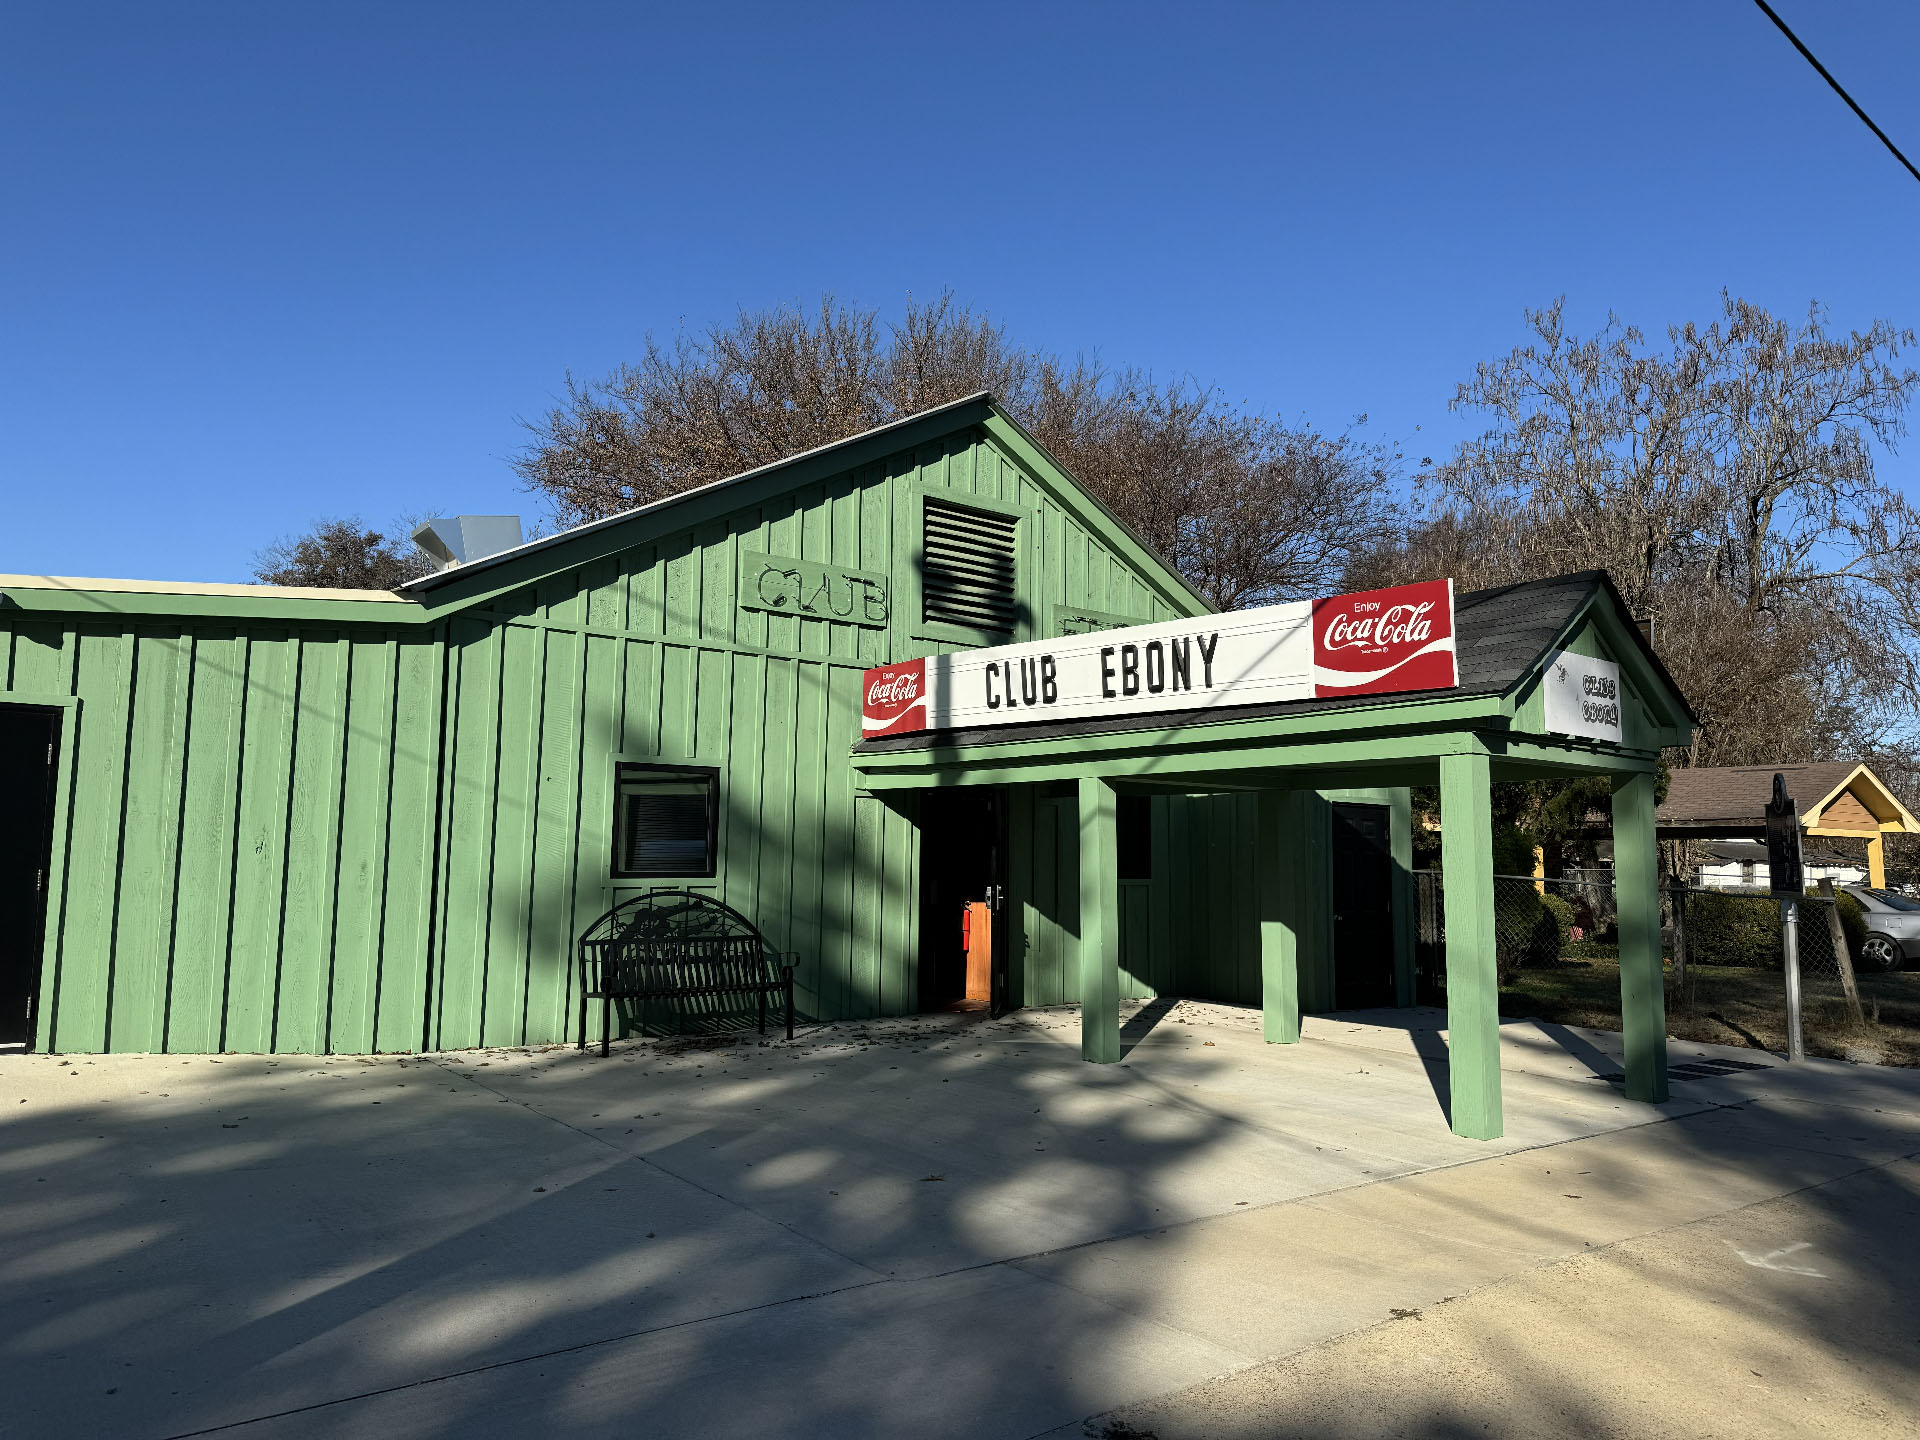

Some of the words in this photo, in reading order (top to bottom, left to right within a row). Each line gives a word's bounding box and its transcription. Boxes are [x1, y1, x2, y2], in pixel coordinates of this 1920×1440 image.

[758, 564, 889, 621] CLUB
[1354, 602, 1381, 613] Enjoy
[1323, 601, 1436, 651] Coca-Cola
[867, 672, 920, 706] Coca-Cola
[985, 654, 1058, 709] CLUB
[1100, 633, 1219, 699] EBONY
